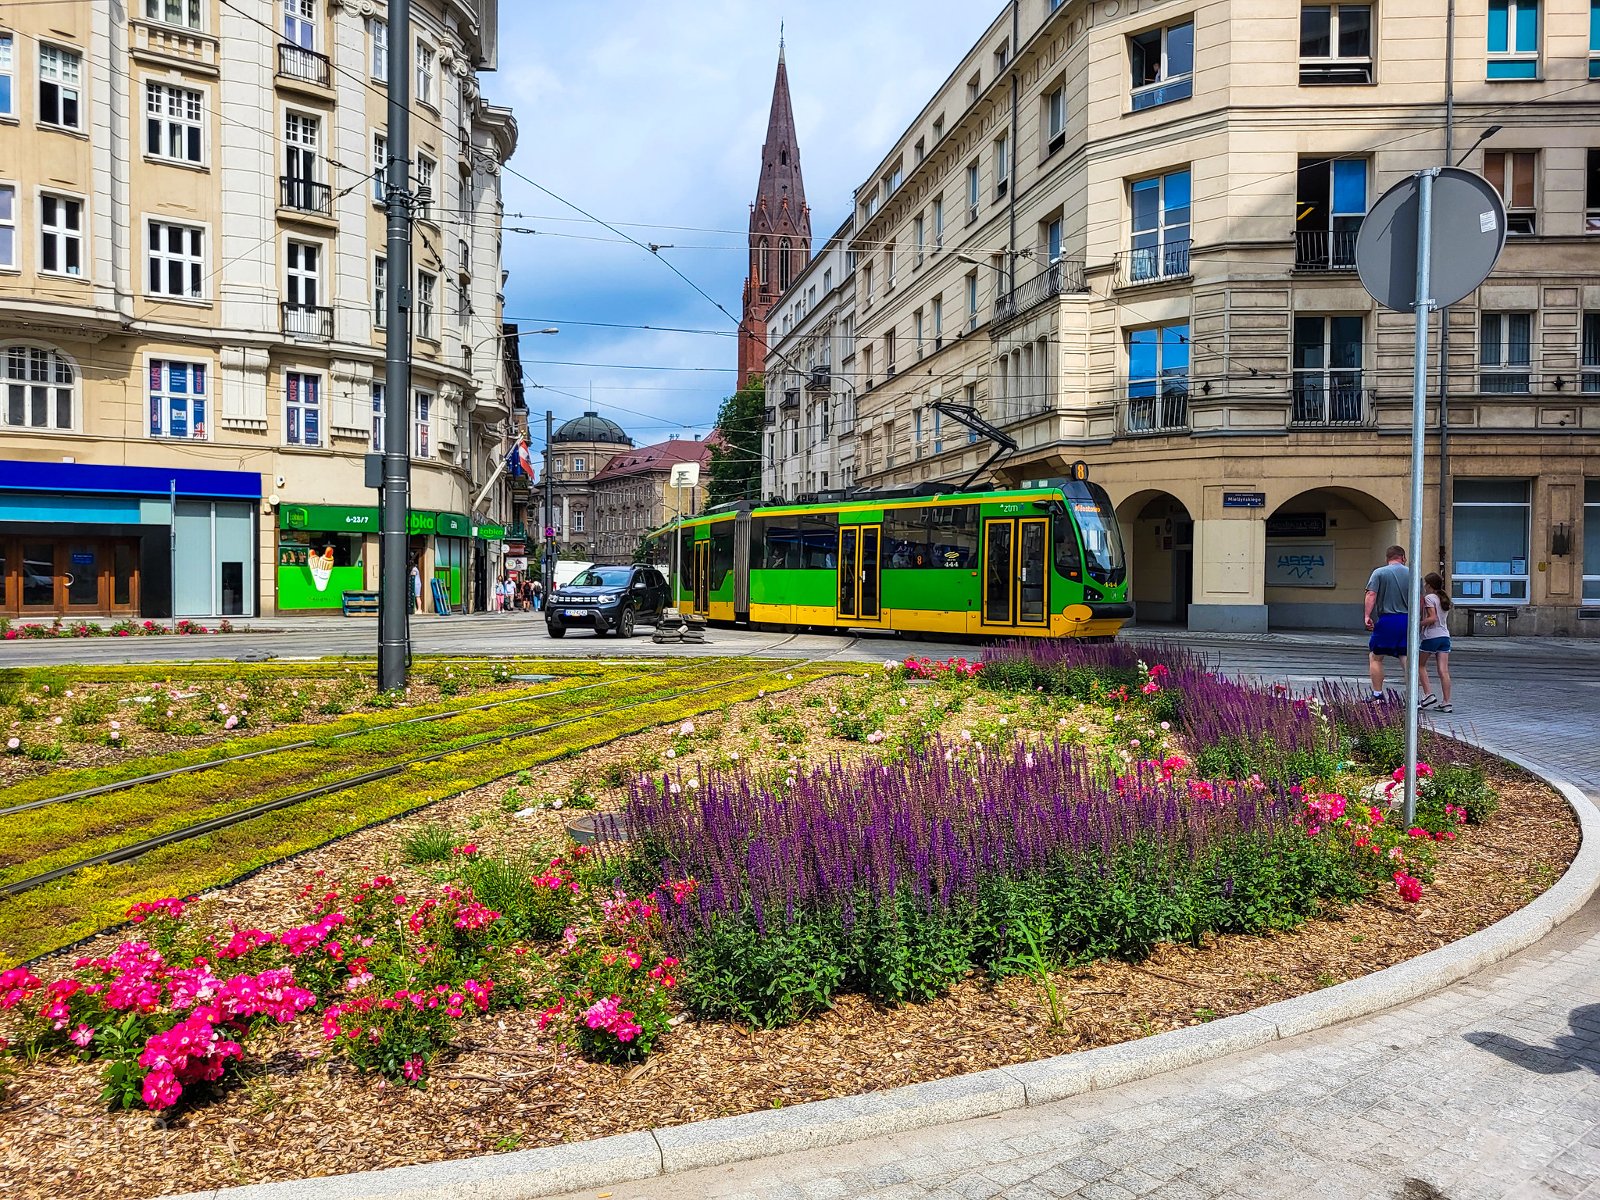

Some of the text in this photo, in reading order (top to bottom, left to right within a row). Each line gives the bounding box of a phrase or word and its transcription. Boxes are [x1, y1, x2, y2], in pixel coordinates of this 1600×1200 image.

[1077, 464, 1085, 480] 8
[1003, 504, 1019, 513] ztm
[345, 515, 369, 524] 6-23/7
[916, 555, 923, 565] 8
